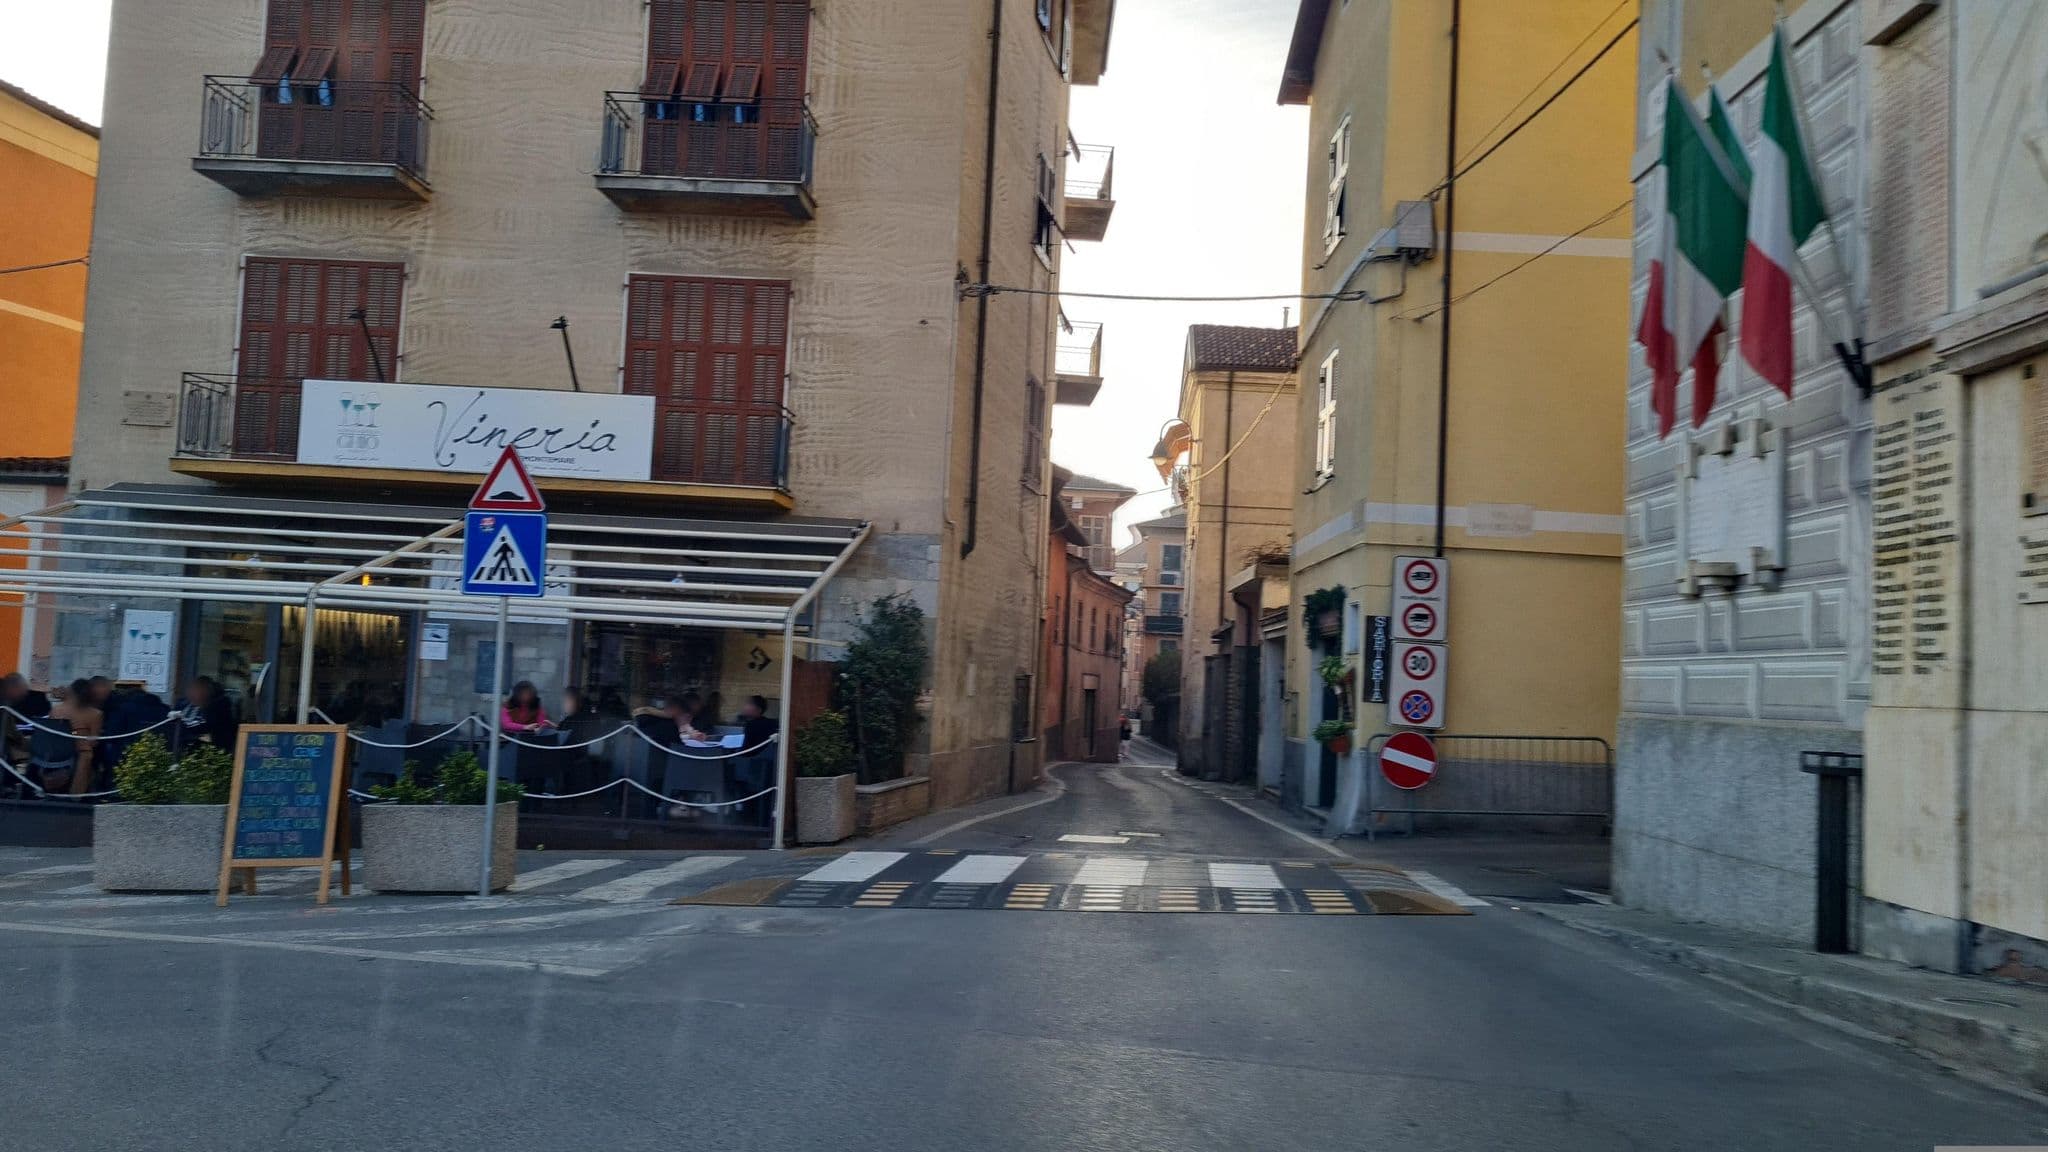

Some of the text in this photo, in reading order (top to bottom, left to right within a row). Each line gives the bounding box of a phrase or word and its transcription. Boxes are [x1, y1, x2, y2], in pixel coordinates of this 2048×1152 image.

[427, 391, 617, 467] Vineria
[1371, 616, 1387, 702] SARTORIA
[1409, 655, 1428, 671] 30
